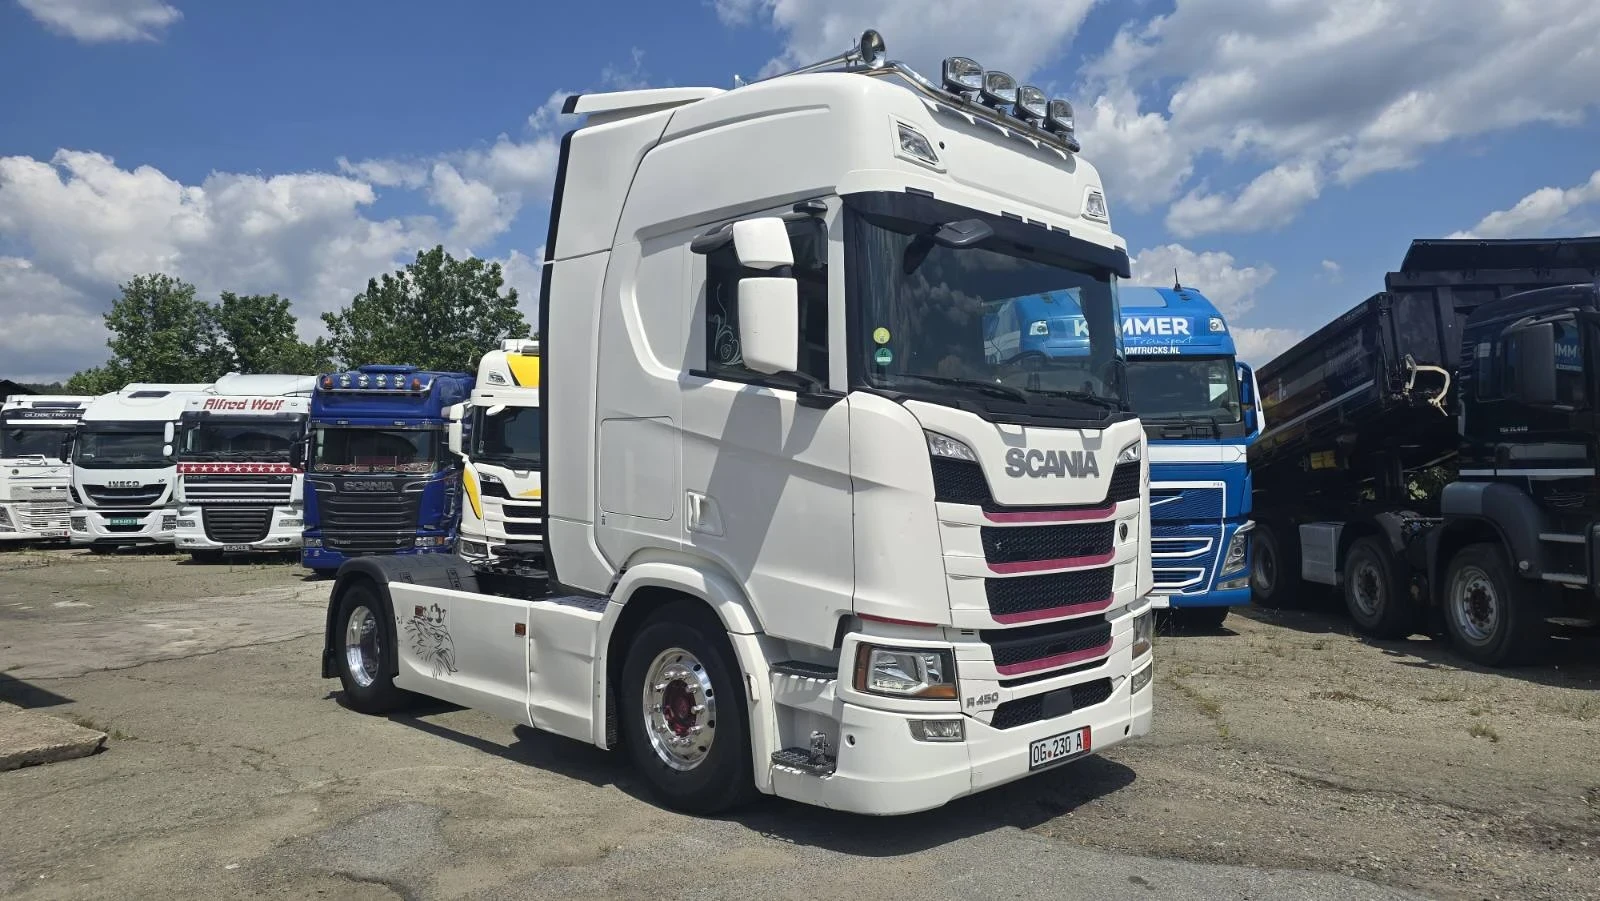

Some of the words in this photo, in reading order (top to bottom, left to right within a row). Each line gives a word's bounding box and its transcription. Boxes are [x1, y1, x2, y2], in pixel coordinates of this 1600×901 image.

[1073, 317, 1190, 336] KMMER
[1124, 346, 1181, 355] OMTRUCKS.NL
[203, 398, 248, 410] Alfred
[251, 399, 285, 411] Wolf
[1005, 447, 1099, 478] SCANIA
[108, 480, 140, 488] IVECO
[344, 481, 394, 491] SCANIA
[966, 697, 975, 708] R
[976, 691, 999, 706] 450
[1053, 737, 1072, 758] 230
[1076, 733, 1082, 750] A
